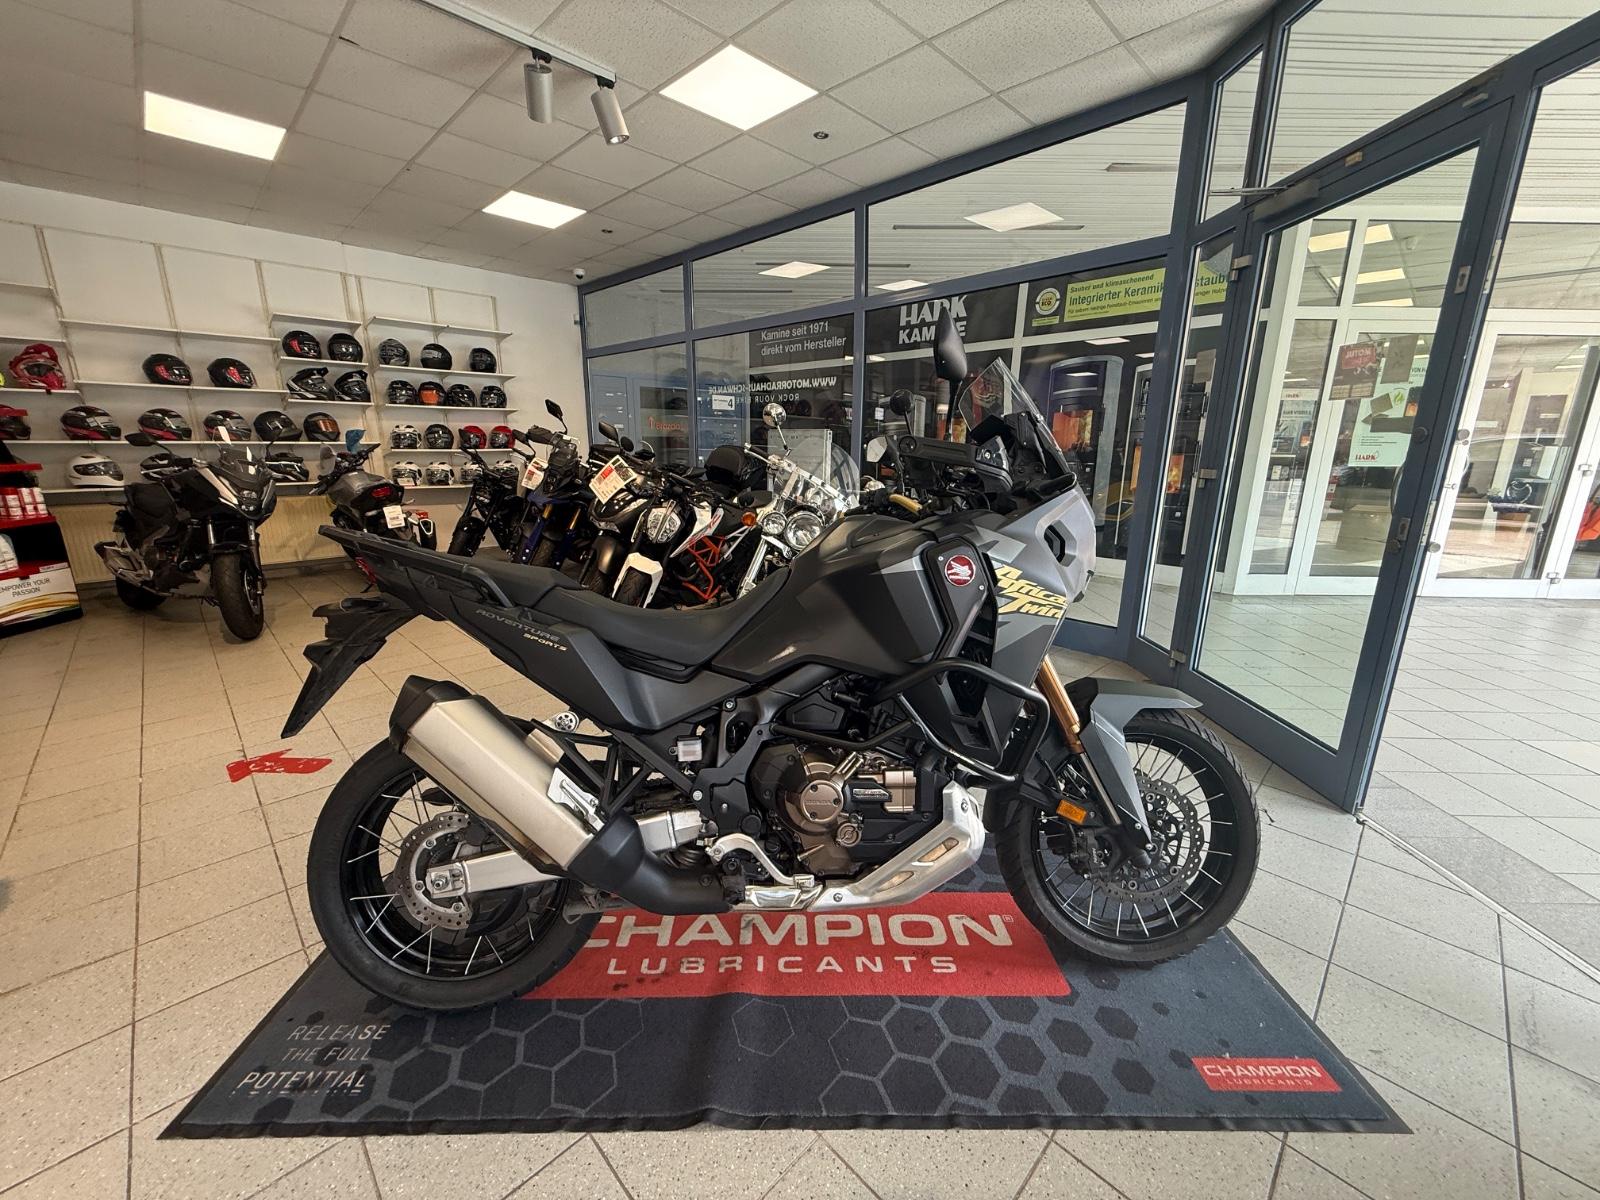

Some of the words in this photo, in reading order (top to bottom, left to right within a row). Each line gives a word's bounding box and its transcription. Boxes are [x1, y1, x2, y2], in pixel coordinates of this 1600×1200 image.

[1069, 290, 1121, 306] Integrierter
[900, 295, 968, 326] HARK
[761, 329, 790, 341] Kamine
[792, 324, 807, 337] seit
[809, 320, 829, 334] 1971
[898, 321, 967, 344] KAME
[761, 344, 783, 356] direkt
[785, 342, 802, 352] vom
[803, 336, 847, 350] Hersteller
[33, 578, 50, 586] YOUR
[12, 586, 41, 598] PASSION
[998, 591, 1067, 619] Twin
[475, 609, 560, 642] ADVENTURE
[523, 633, 567, 651] SPORTS
[607, 956, 957, 975] LUBRICANTS
[287, 1025, 391, 1041] RELEASE
[281, 1048, 321, 1062] THE
[323, 1047, 371, 1061] FULL
[236, 1070, 366, 1089] POTENTIAL
[1203, 1064, 1322, 1078] CHAMPION
[1226, 1078, 1312, 1086] LUBRICANTS
